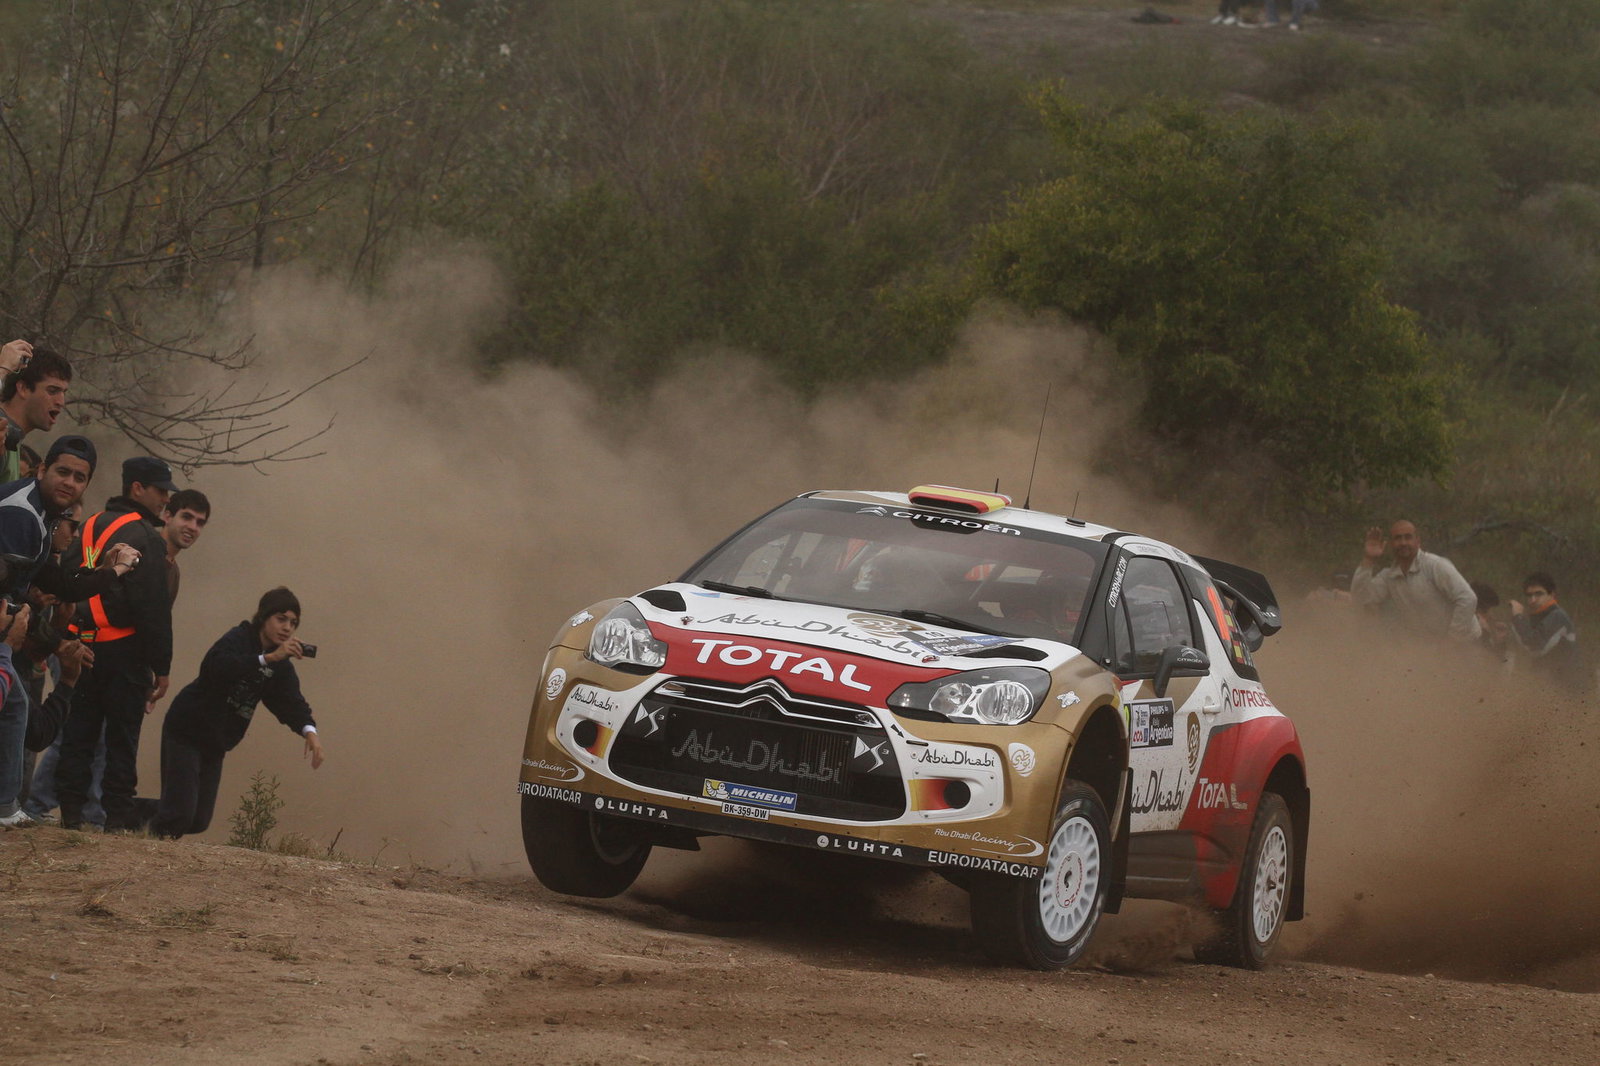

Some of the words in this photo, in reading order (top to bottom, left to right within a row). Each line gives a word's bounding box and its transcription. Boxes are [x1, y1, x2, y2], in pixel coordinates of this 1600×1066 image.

[892, 510, 1021, 536] CITROËN
[692, 638, 872, 692] TOTAL
[539, 759, 575, 777] Racing
[517, 782, 582, 804] EURODATACAR
[731, 788, 794, 804] MICHELIN
[1198, 778, 1248, 809] TOTAL
[608, 800, 669, 819] LUHTA
[724, 803, 767, 818] BK-359-DW
[834, 838, 903, 857] LUHTA
[934, 828, 950, 837] Abu
[950, 830, 971, 840] Dhabi
[971, 832, 1031, 851] Racing
[928, 850, 1039, 878] EURODATACAR
